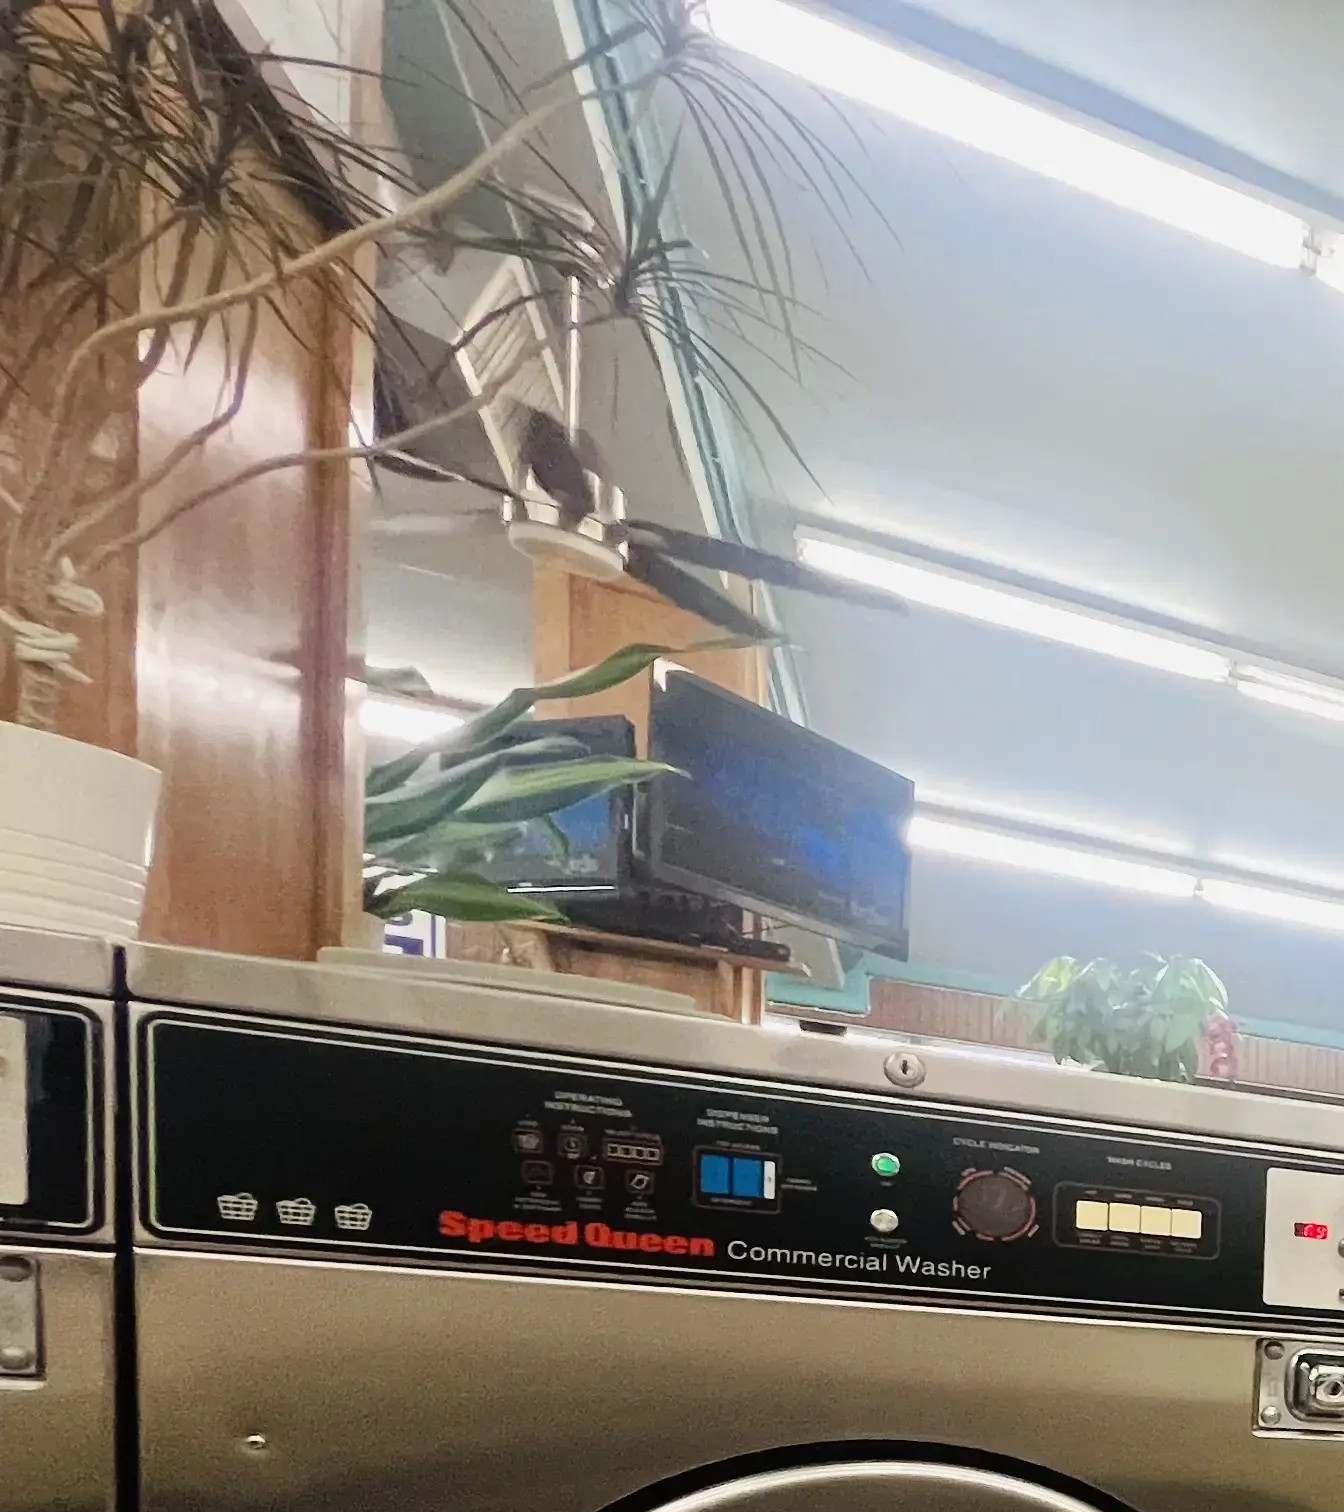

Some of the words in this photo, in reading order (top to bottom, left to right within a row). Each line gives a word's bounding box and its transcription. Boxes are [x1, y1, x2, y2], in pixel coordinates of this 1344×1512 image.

[438, 1210, 578, 1246] Speed
[584, 1222, 716, 1258] Queen
[726, 1239, 888, 1272] Commercial
[896, 1254, 992, 1280] Washer
